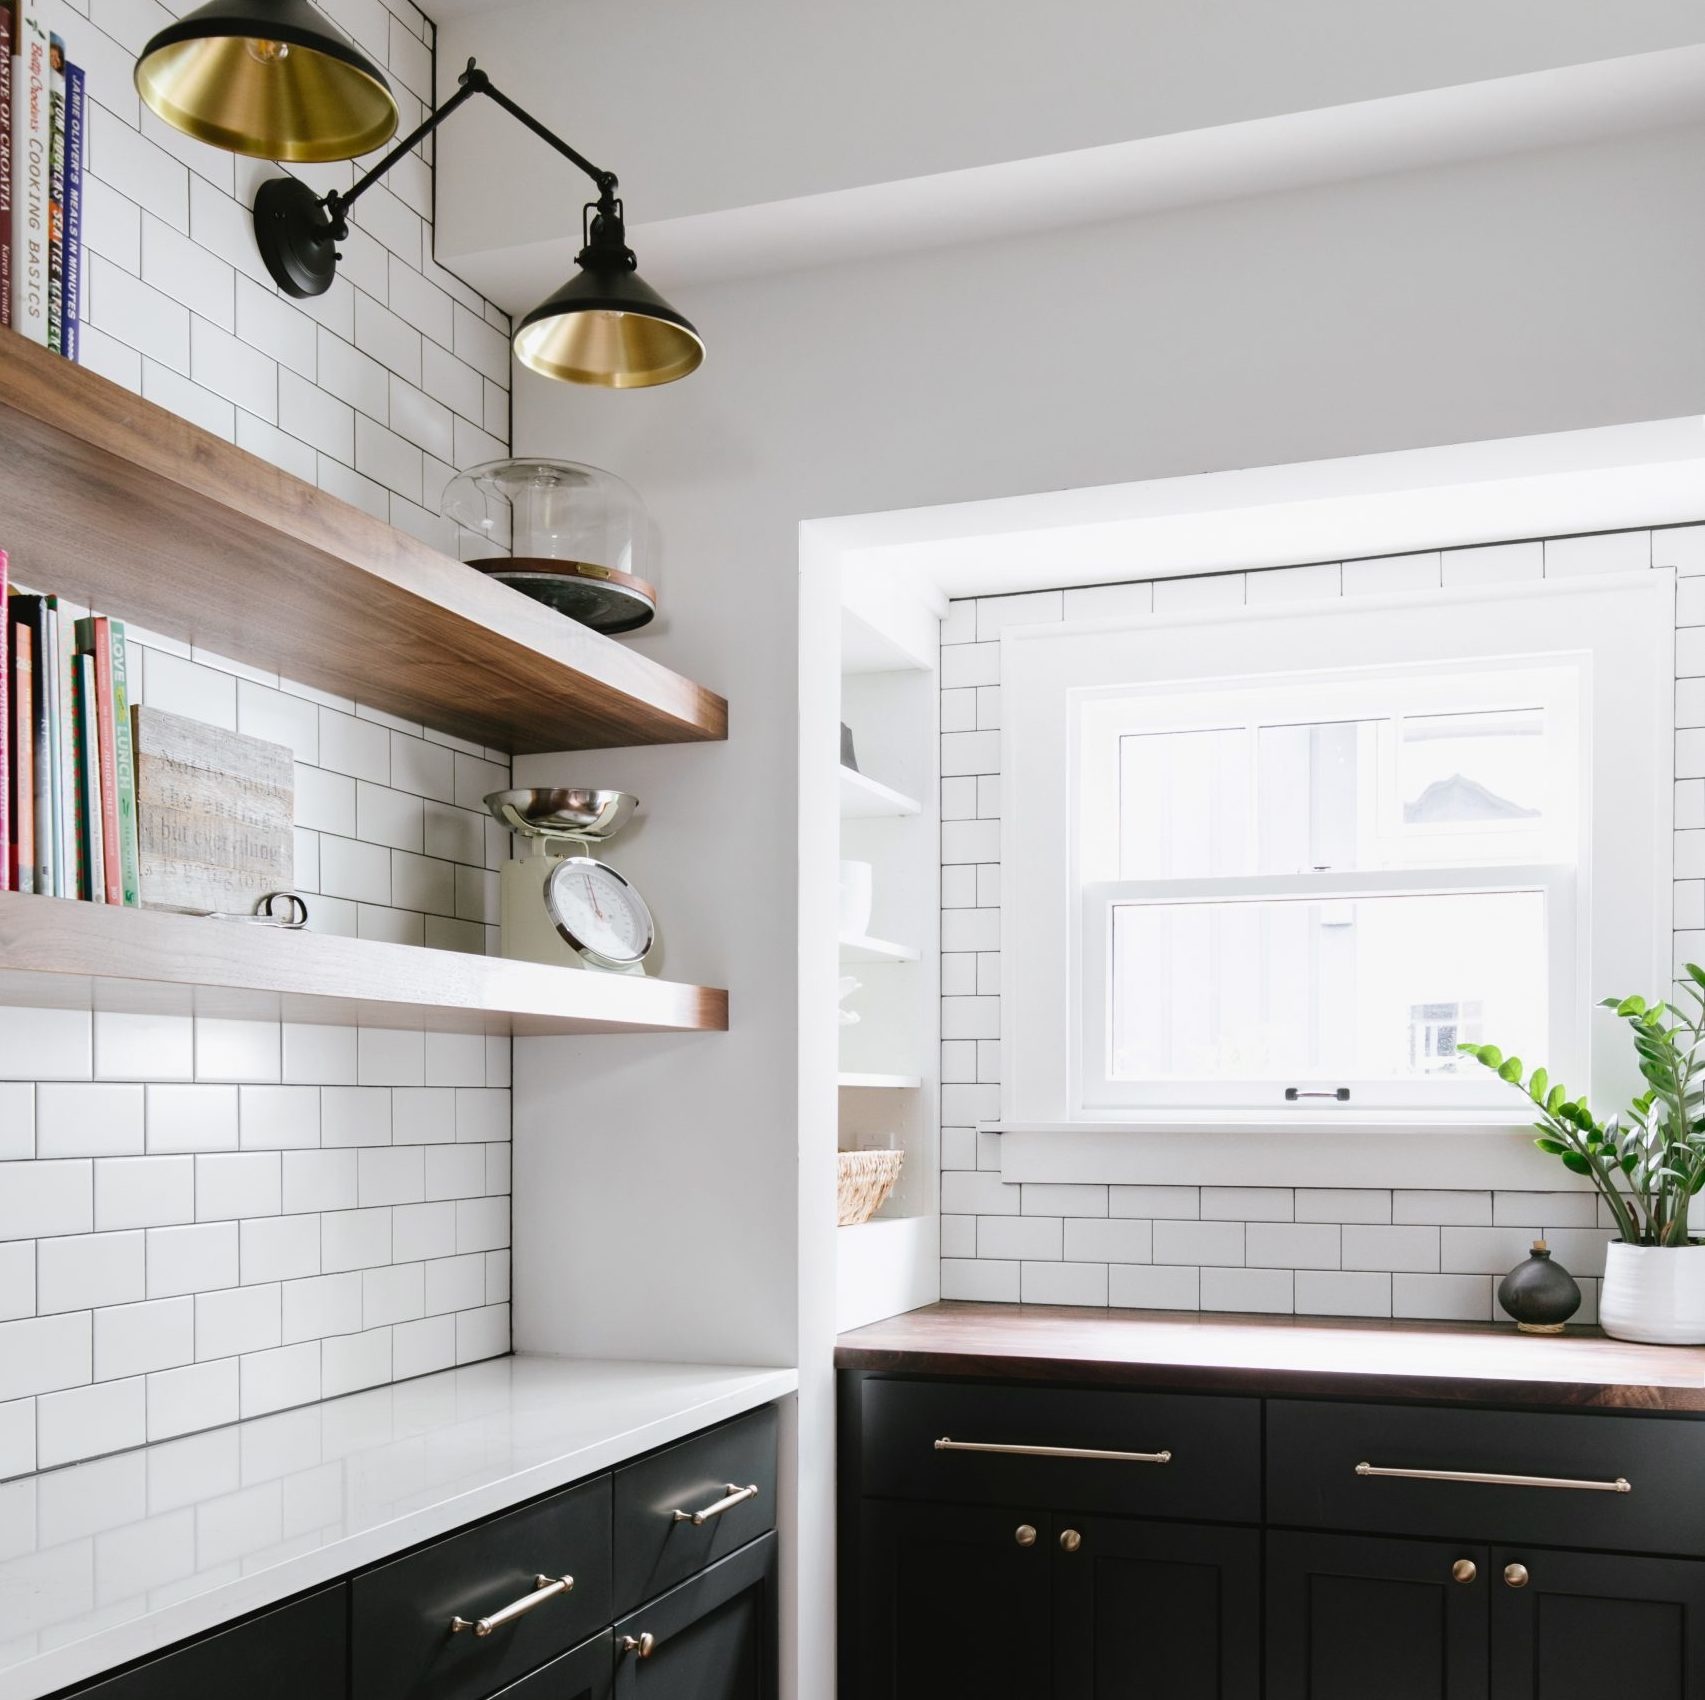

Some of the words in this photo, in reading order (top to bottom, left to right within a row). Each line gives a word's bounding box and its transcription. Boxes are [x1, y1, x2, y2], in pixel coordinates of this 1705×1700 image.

[0, 44, 10, 98] TASTE
[29, 42, 43, 74] Betty
[0, 103, 10, 129] OF
[55, 99, 65, 132] TOM
[71, 75, 82, 117] JAMIE
[0, 133, 10, 211] CROATIA
[69, 118, 81, 184] OLIVER'S
[69, 188, 80, 236] MEALS
[2, 244, 10, 275] Karen
[51, 209, 63, 276] SEATTLE
[68, 237, 78, 254] IN
[1, 278, 10, 324] Evenden
[29, 239, 40, 318] BASICS
[67, 255, 78, 320] MINUTES
[112, 632, 125, 682] LOVE
[117, 725, 131, 789] LUNCH
[161, 816, 188, 843] but
